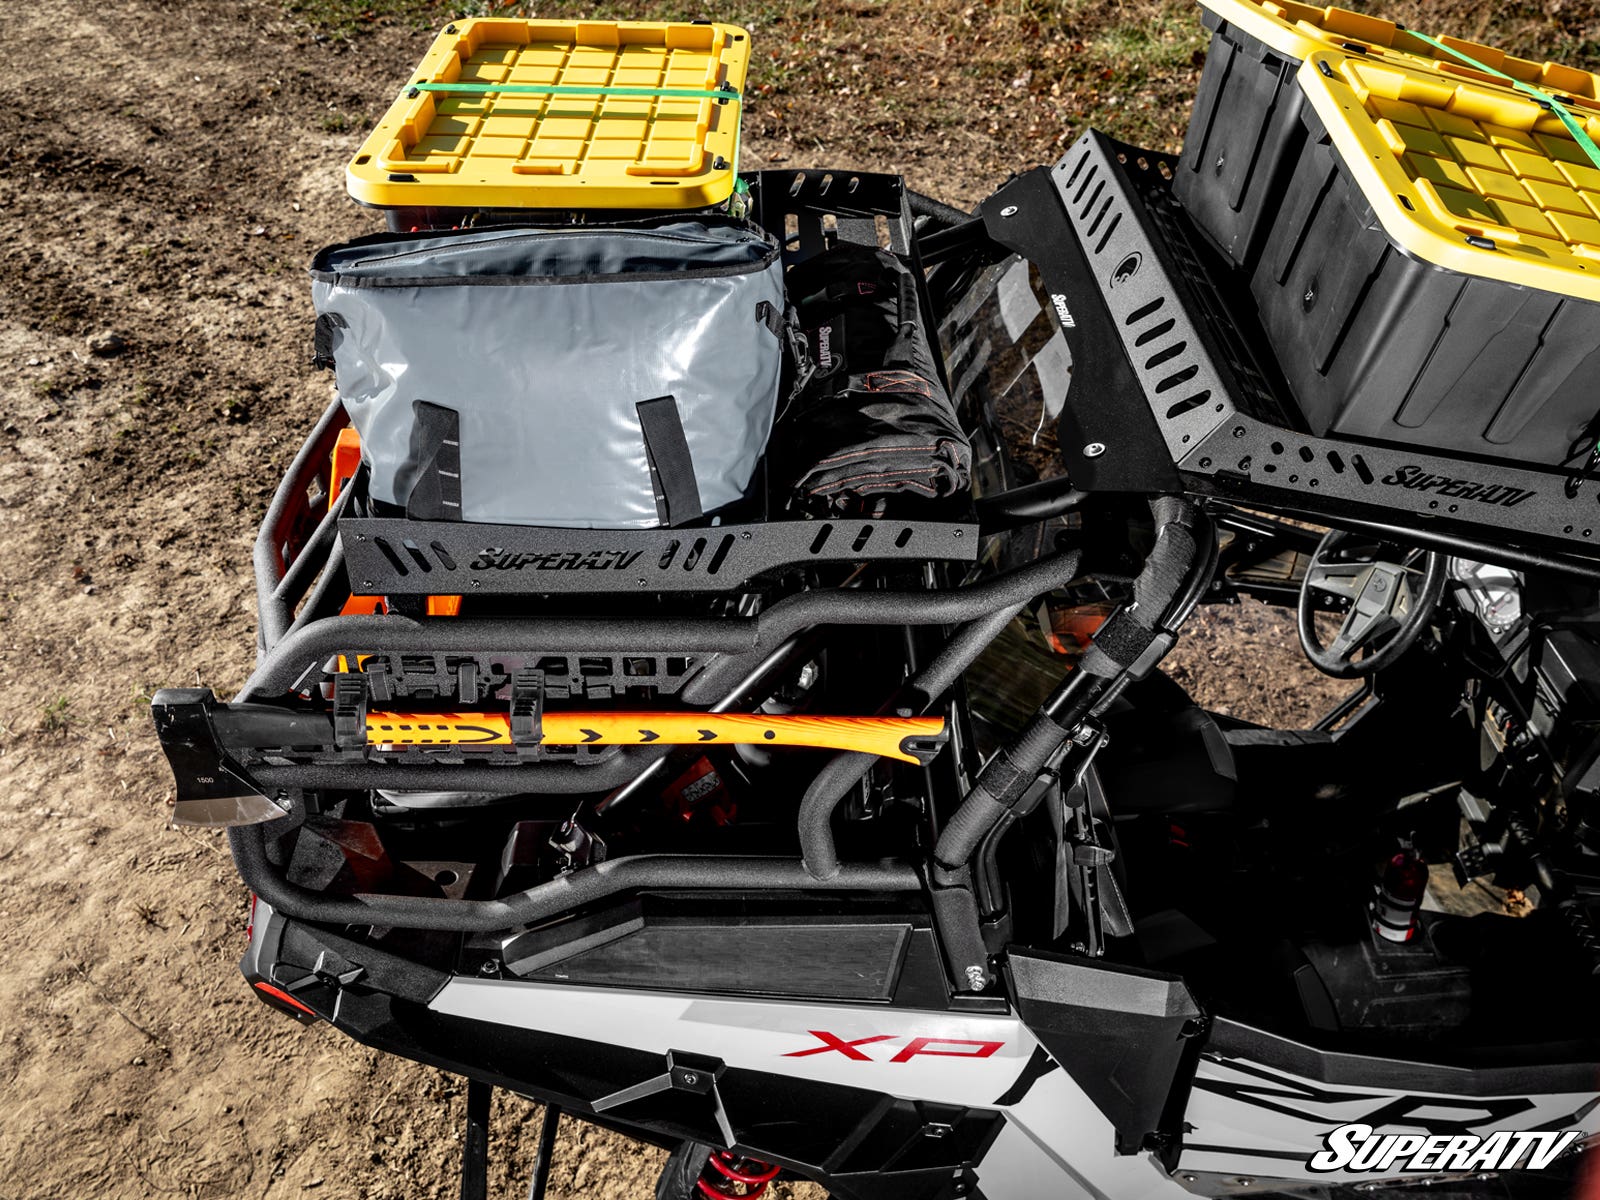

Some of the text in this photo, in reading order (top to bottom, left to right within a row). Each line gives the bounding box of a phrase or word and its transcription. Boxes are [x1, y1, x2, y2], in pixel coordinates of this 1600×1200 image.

[1381, 465, 1537, 507] SUPERATV
[469, 548, 645, 571] SUPERATV
[196, 776, 214, 784] 1500
[780, 1029, 1006, 1063] XP
